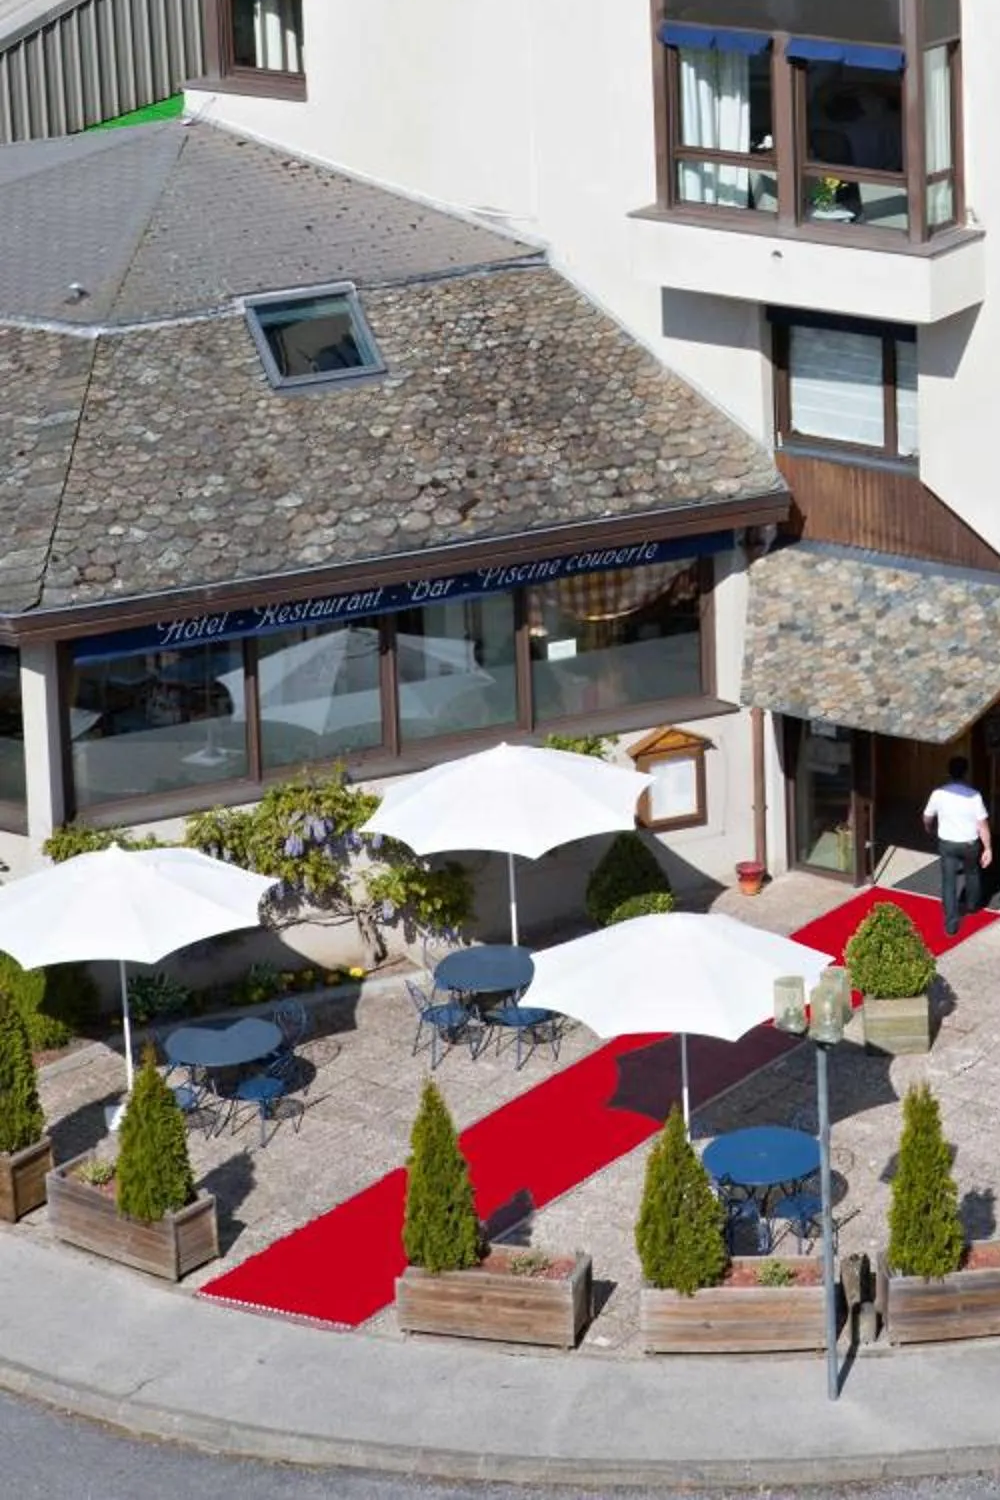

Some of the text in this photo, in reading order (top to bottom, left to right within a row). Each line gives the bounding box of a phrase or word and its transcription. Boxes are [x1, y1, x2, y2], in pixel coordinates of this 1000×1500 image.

[253, 587, 384, 628] Restaurant
[407, 579, 454, 601] Bar
[476, 558, 562, 588] Piscine
[565, 540, 660, 571] couverte
